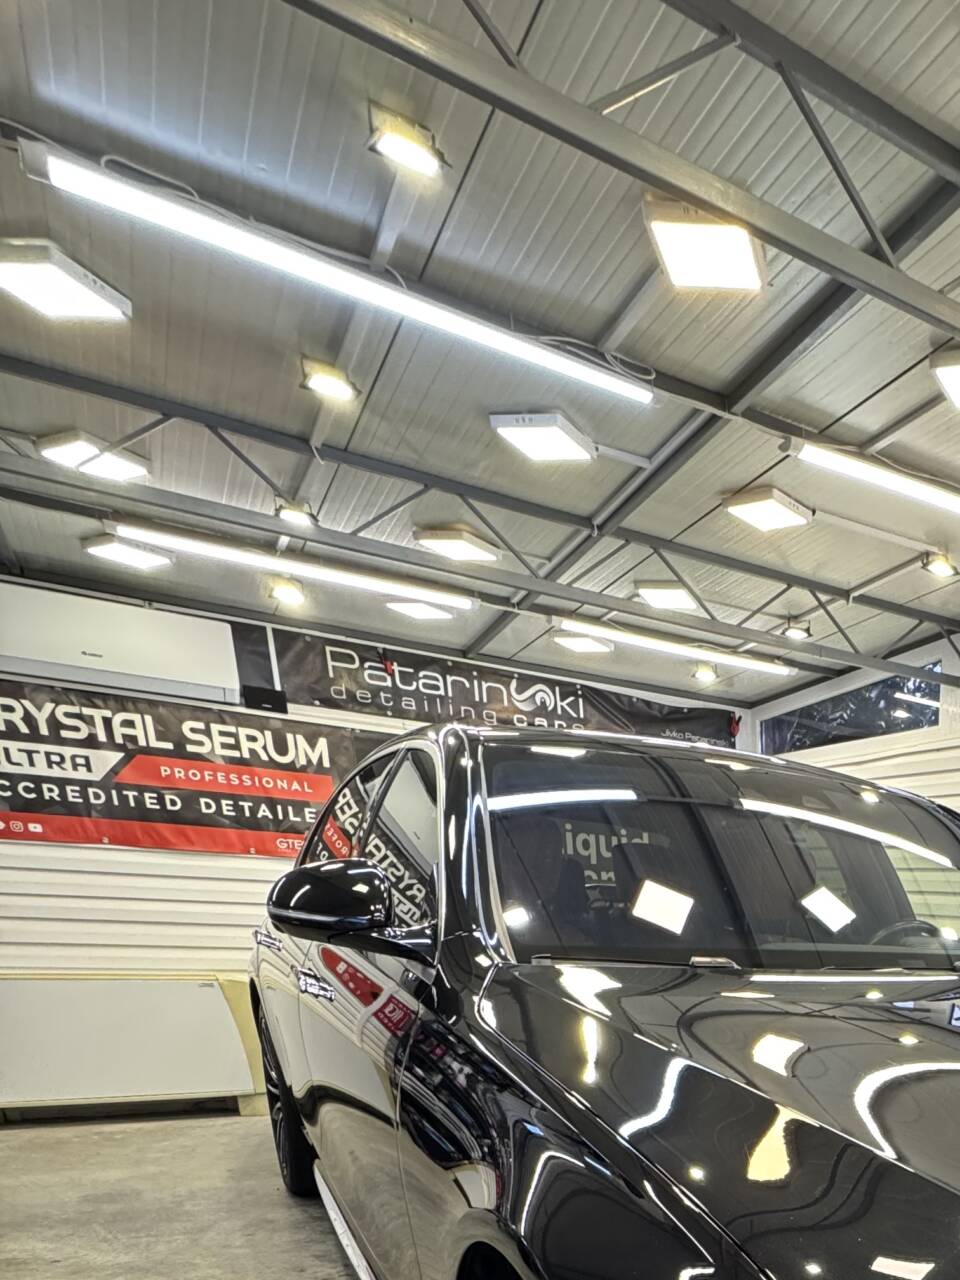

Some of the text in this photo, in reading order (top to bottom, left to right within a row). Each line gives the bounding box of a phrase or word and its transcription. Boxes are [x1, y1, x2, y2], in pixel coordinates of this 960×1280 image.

[330, 683, 497, 726] detailing
[0, 697, 331, 768] RYSTAL SERUM
[0, 747, 93, 773] LTRA
[160, 766, 313, 793] PROFESSIONAL
